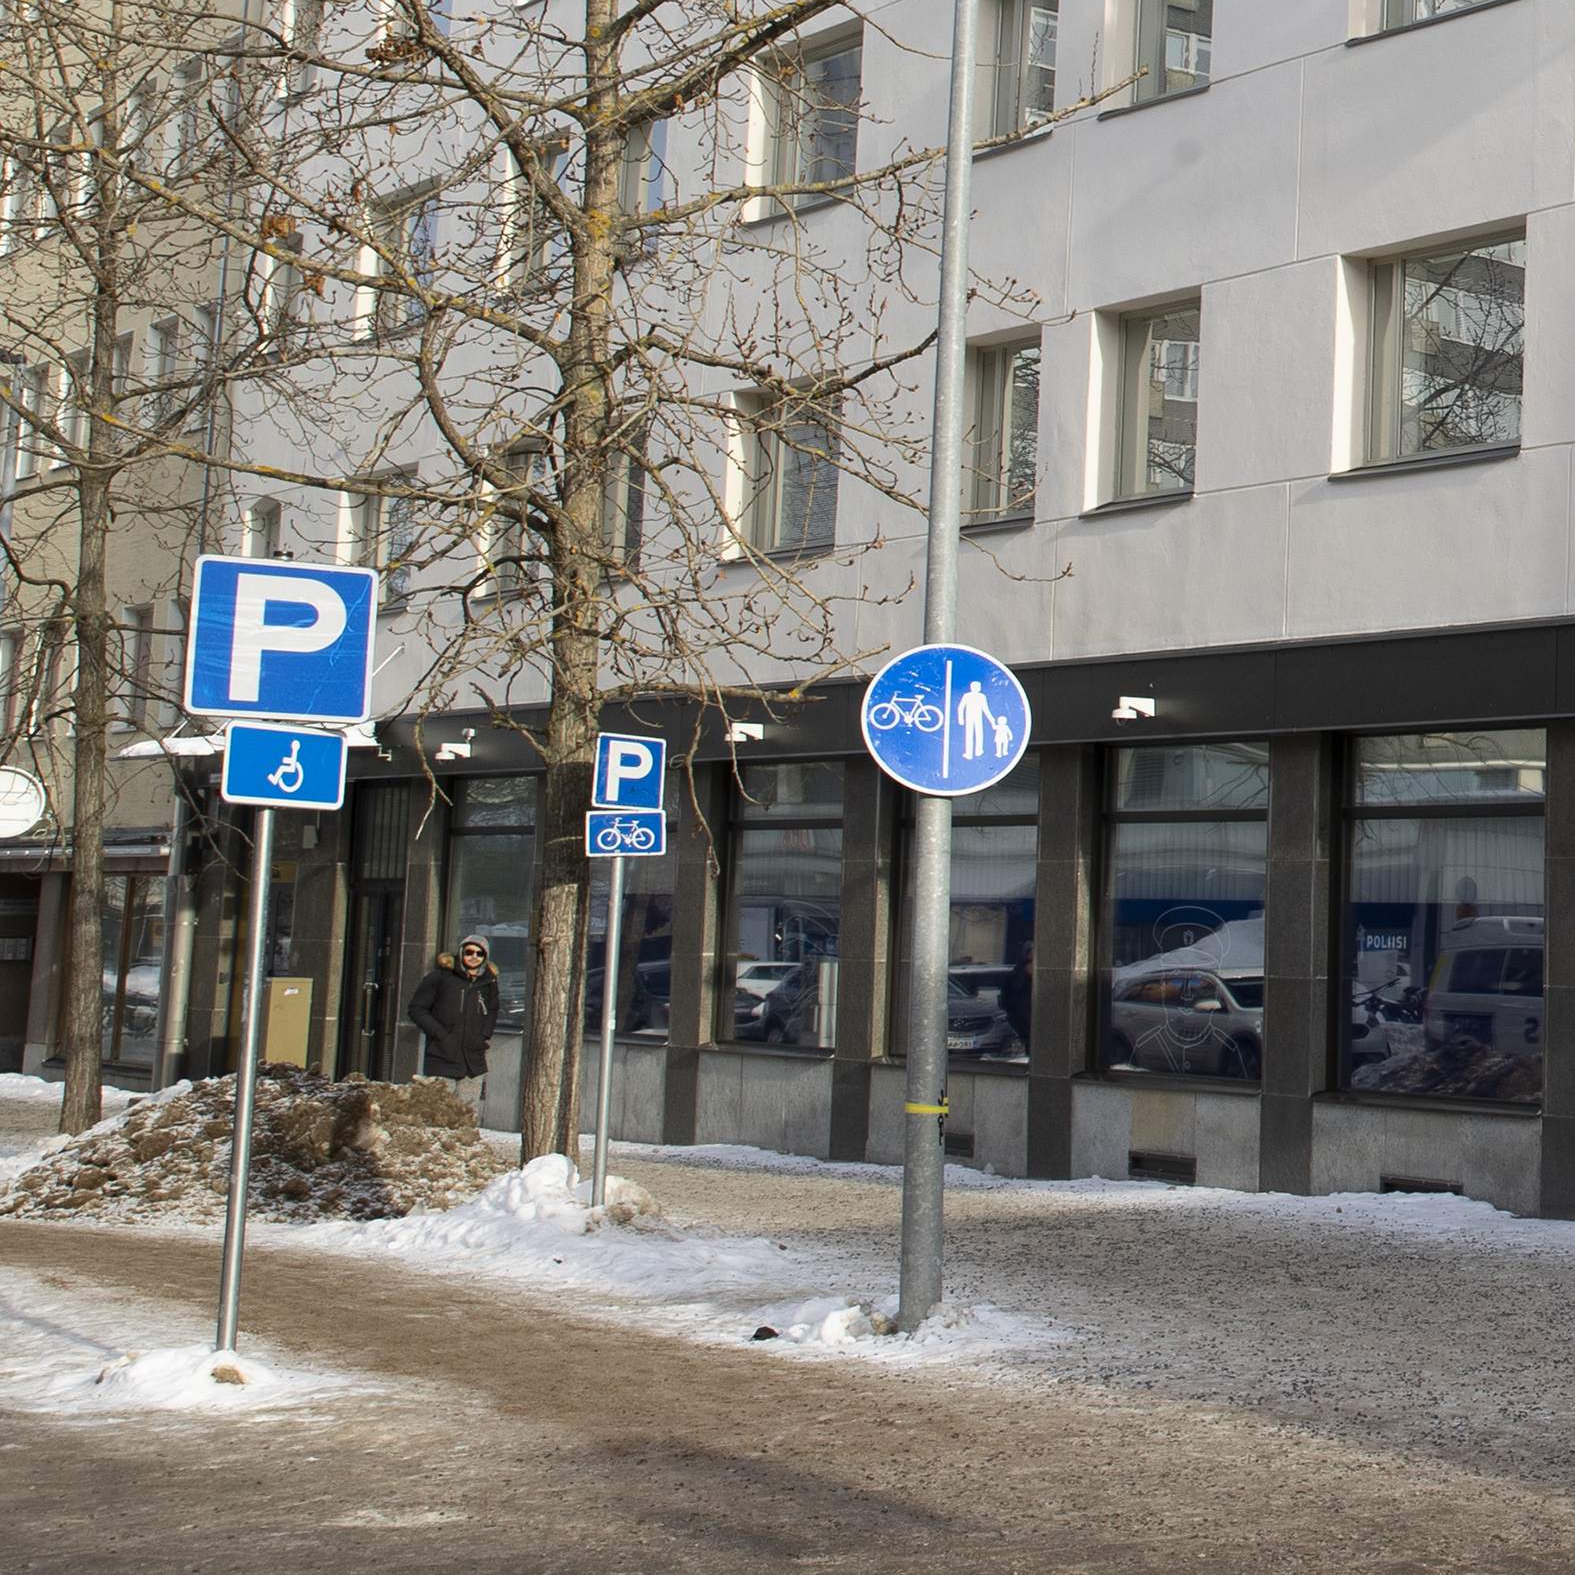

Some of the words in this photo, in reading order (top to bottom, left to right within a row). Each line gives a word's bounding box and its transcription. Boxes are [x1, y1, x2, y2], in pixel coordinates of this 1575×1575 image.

[228, 572, 348, 702] P
[604, 741, 654, 802] P
[1366, 935, 1407, 950] POLIISI
